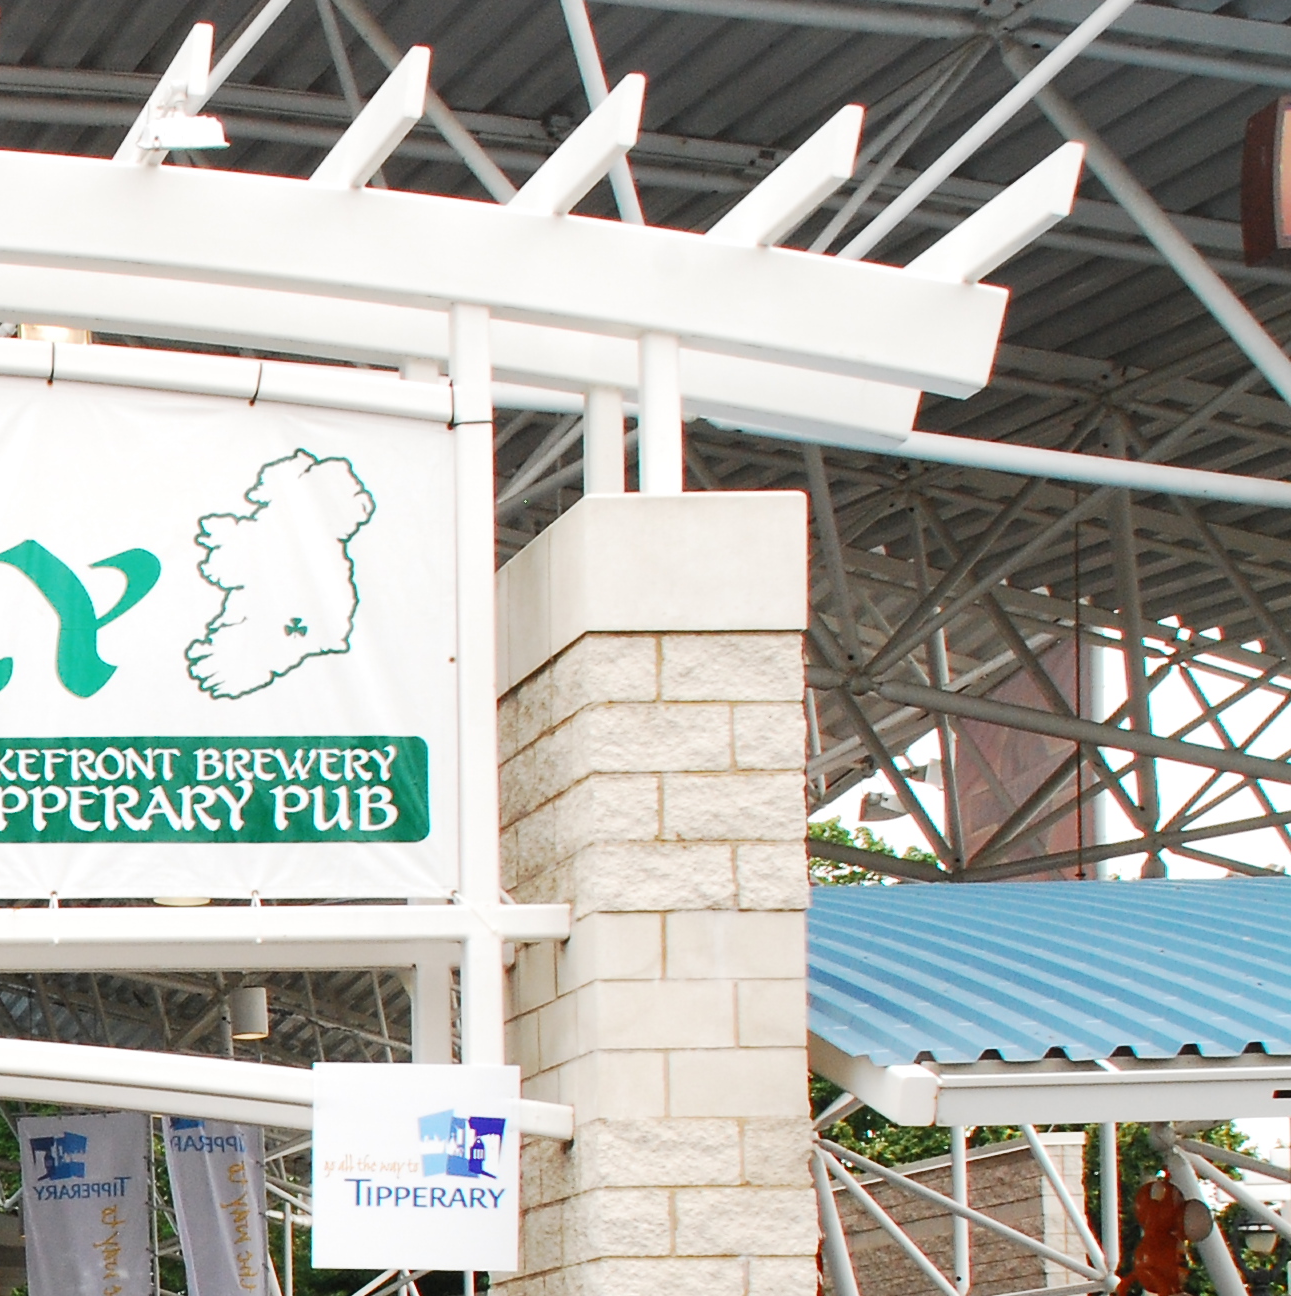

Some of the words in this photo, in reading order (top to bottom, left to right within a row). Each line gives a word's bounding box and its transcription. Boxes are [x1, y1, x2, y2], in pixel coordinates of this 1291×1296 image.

[195, 745, 398, 782] BREWERY
[269, 784, 399, 832] PUB
[338, 1154, 355, 1172] all
[357, 1154, 377, 1173] the
[380, 1161, 405, 1179] way
[407, 1157, 419, 1173] to
[344, 1178, 506, 1209] TIPPERARY
